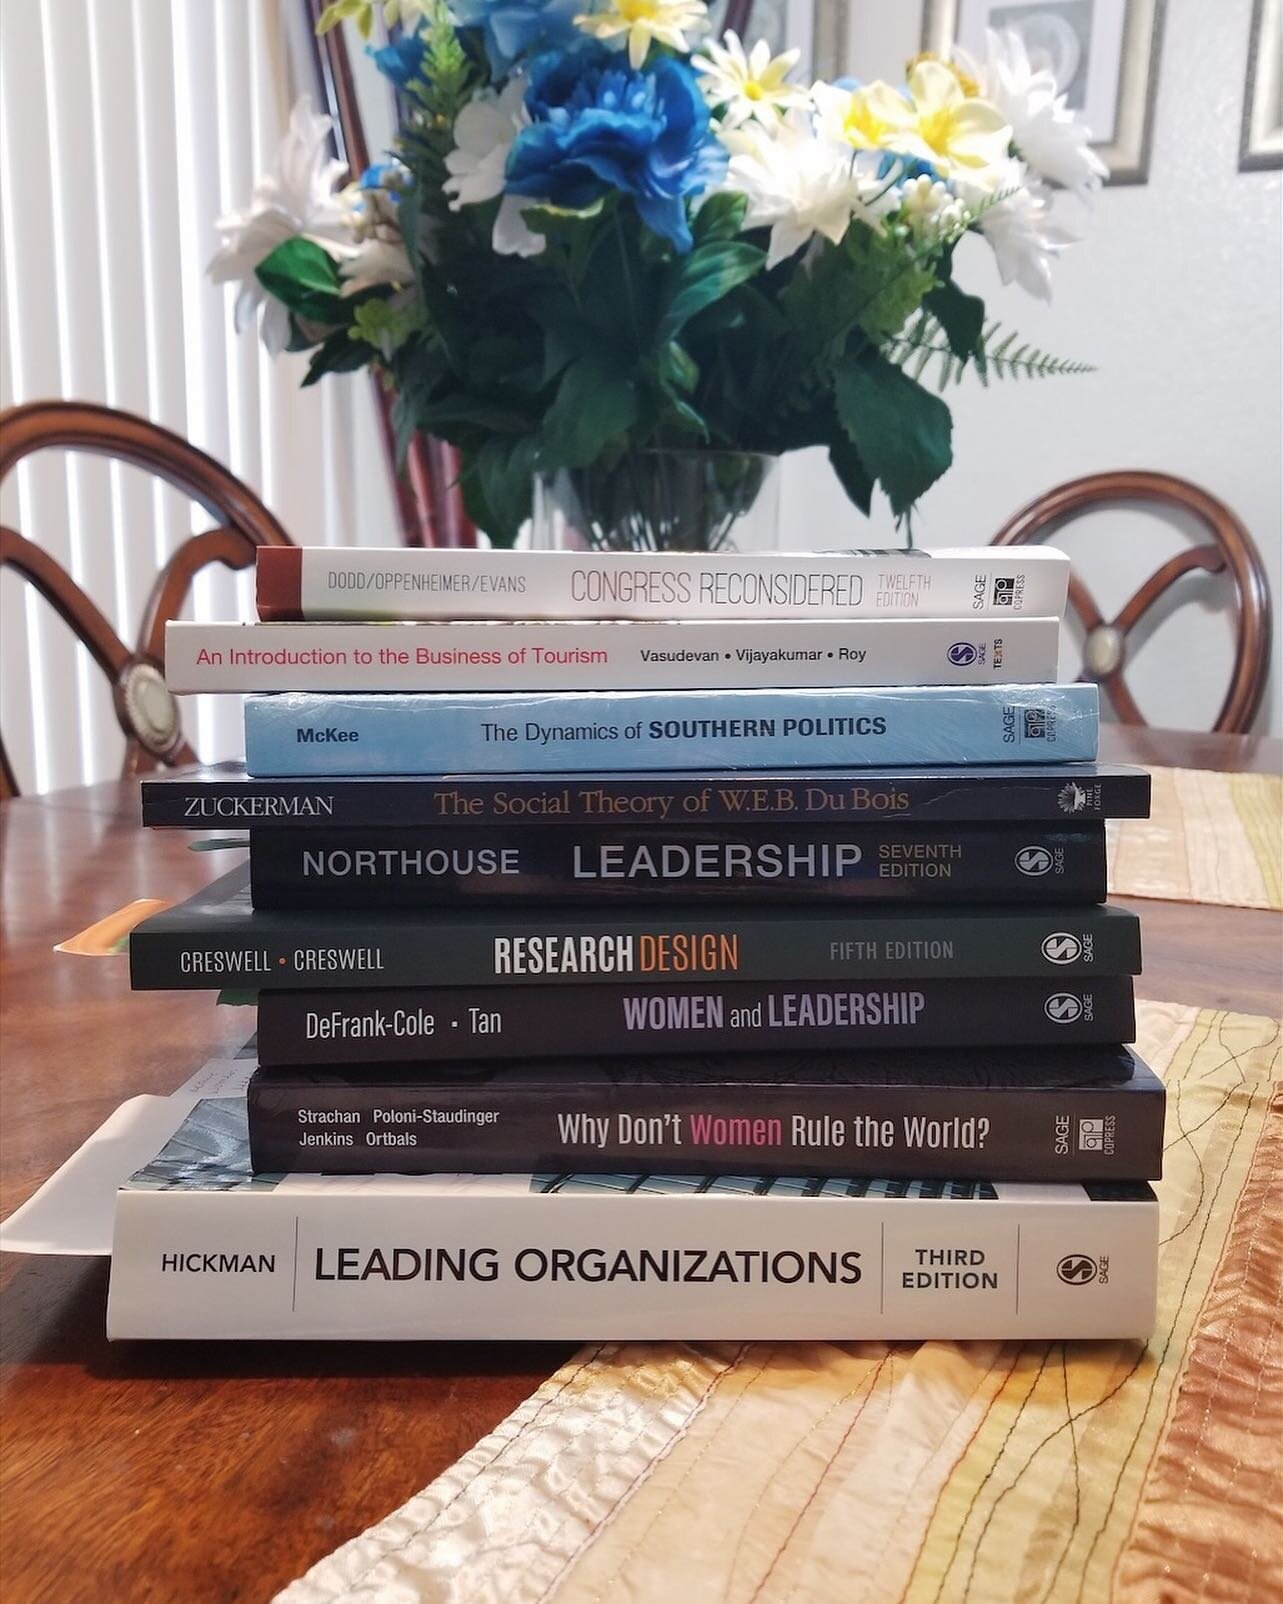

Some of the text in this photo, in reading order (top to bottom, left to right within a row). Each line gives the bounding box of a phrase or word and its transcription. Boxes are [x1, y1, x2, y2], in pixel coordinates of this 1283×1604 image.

[327, 571, 526, 594] DODD/OPPENHEIMER/EVANS
[571, 569, 863, 607] CONGRESS RECONSIDERED
[878, 573, 931, 591] TWELFTH
[973, 574, 987, 610] SAGE
[876, 591, 920, 608] EDITION
[196, 646, 608, 666] An Introduction to the Business of Tourism
[640, 646, 867, 664] Vasudevan Vijayakumar Roy
[978, 642, 987, 665] SAGE
[296, 727, 360, 743] McKee
[481, 716, 887, 746] The Dynamics of SOUTHERN POLITICS
[1002, 706, 1015, 743] SAGE
[184, 795, 335, 817] ZUCKERMAN
[434, 786, 910, 819] The Social Theory of W.E.B. Du Bois
[303, 849, 520, 876] NORTHOUSE
[573, 843, 863, 878] LEADERSHIP
[878, 844, 962, 859] SEVENTH
[1055, 847, 1064, 874] SAGE
[879, 863, 952, 878] EDITION
[180, 948, 384, 973] CRESWELL CRESWELL
[494, 933, 739, 974] RESEARCH DESIGN
[830, 940, 954, 961] FIFTH EDITION
[1083, 933, 1093, 962] SAGE
[623, 991, 926, 1030] WOMEN and LEADERSHIP
[1084, 993, 1093, 1022] SAGE
[306, 1007, 502, 1040] DeFrank-Cole Tan
[298, 1109, 500, 1126] Strachan Poloni-Staudinger
[299, 1131, 417, 1146] Jenkins Ortbals
[558, 1113, 991, 1149] Why Don't Women Rule the World?
[1055, 1115, 1069, 1155] SAGE
[162, 1253, 276, 1273] HICKMAN
[315, 1248, 862, 1284] LEADING ORGANIZATIONS
[916, 1249, 985, 1266] THIRD
[1099, 1256, 1109, 1284] SAGE
[902, 1271, 998, 1289] EDITION
